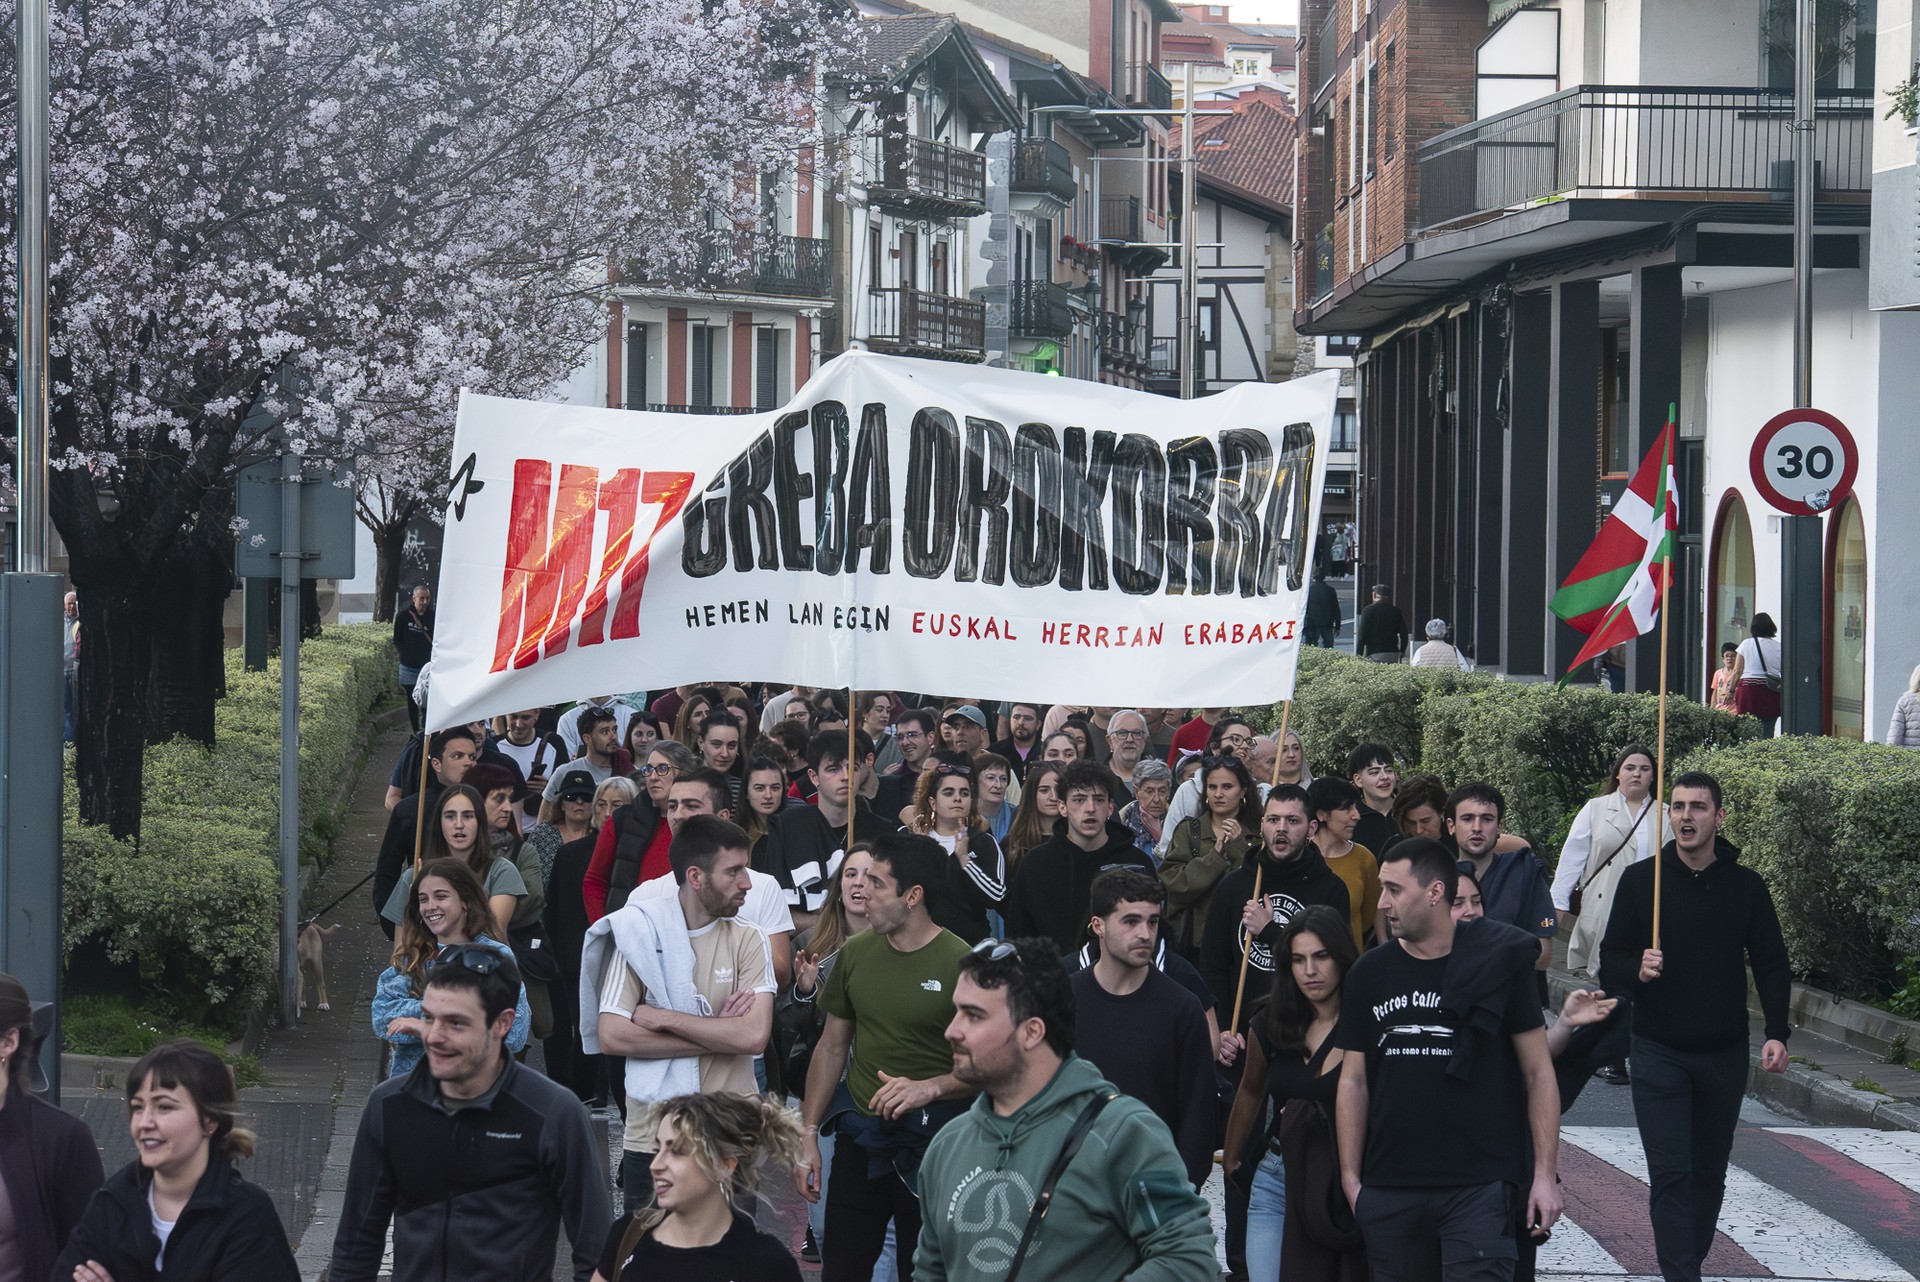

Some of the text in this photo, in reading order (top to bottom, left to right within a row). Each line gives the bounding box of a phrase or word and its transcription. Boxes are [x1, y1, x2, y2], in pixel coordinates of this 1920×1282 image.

[1776, 444, 1834, 479] 30
[682, 400, 1315, 599] GREBA OROKORRA
[489, 458, 694, 674] M17
[686, 599, 1296, 649] HEMEN LAN EGIN EUSKAL HERRIAN ERABAKI
[1373, 994, 1408, 1022] Perros
[1402, 1047, 1420, 1056] como
[946, 1165, 983, 1222] TERNUA
